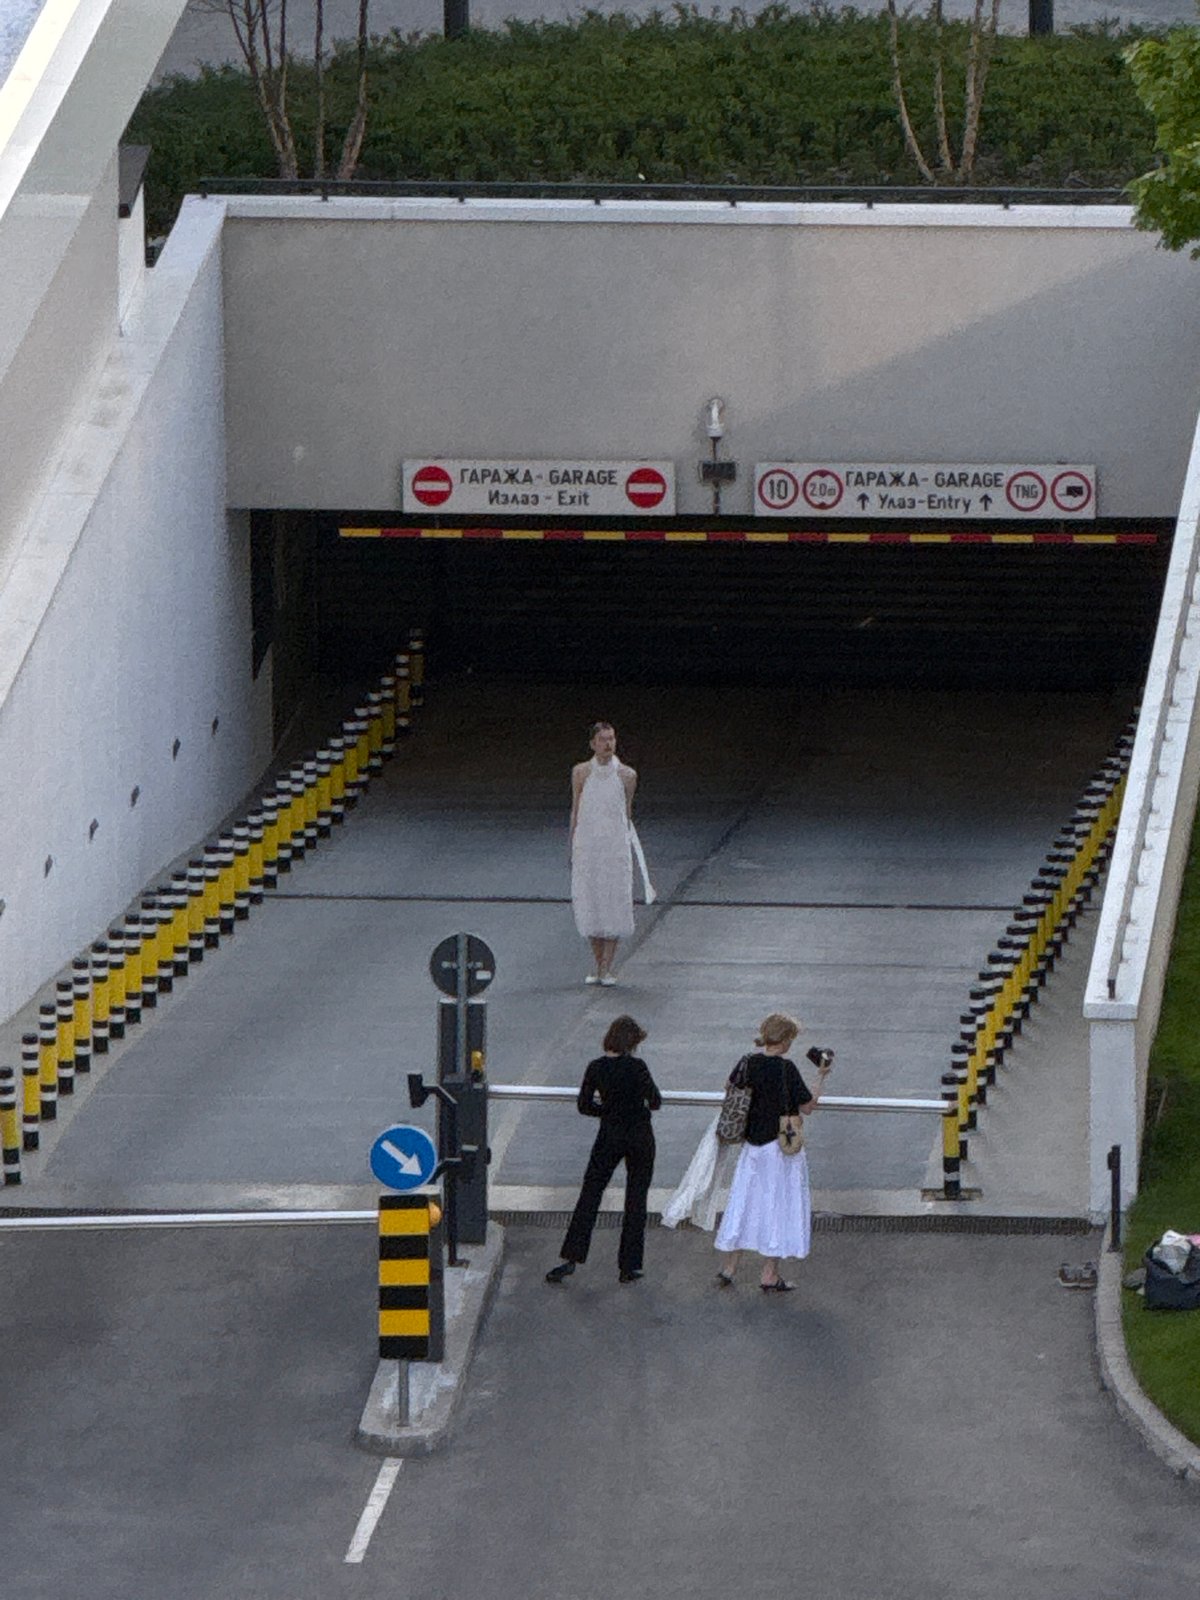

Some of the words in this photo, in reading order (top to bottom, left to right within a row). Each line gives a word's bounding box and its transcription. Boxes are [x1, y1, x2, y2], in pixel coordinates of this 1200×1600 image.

[459, 469, 533, 485] ГАРАЖА
[549, 470, 618, 485] GARAGE
[845, 471, 919, 487] ГАРАЖА
[934, 472, 1004, 488] GARAGE
[488, 490, 539, 505] Излаз
[558, 491, 589, 505] Exit
[769, 479, 788, 500] 10
[1014, 484, 1039, 499] TNG
